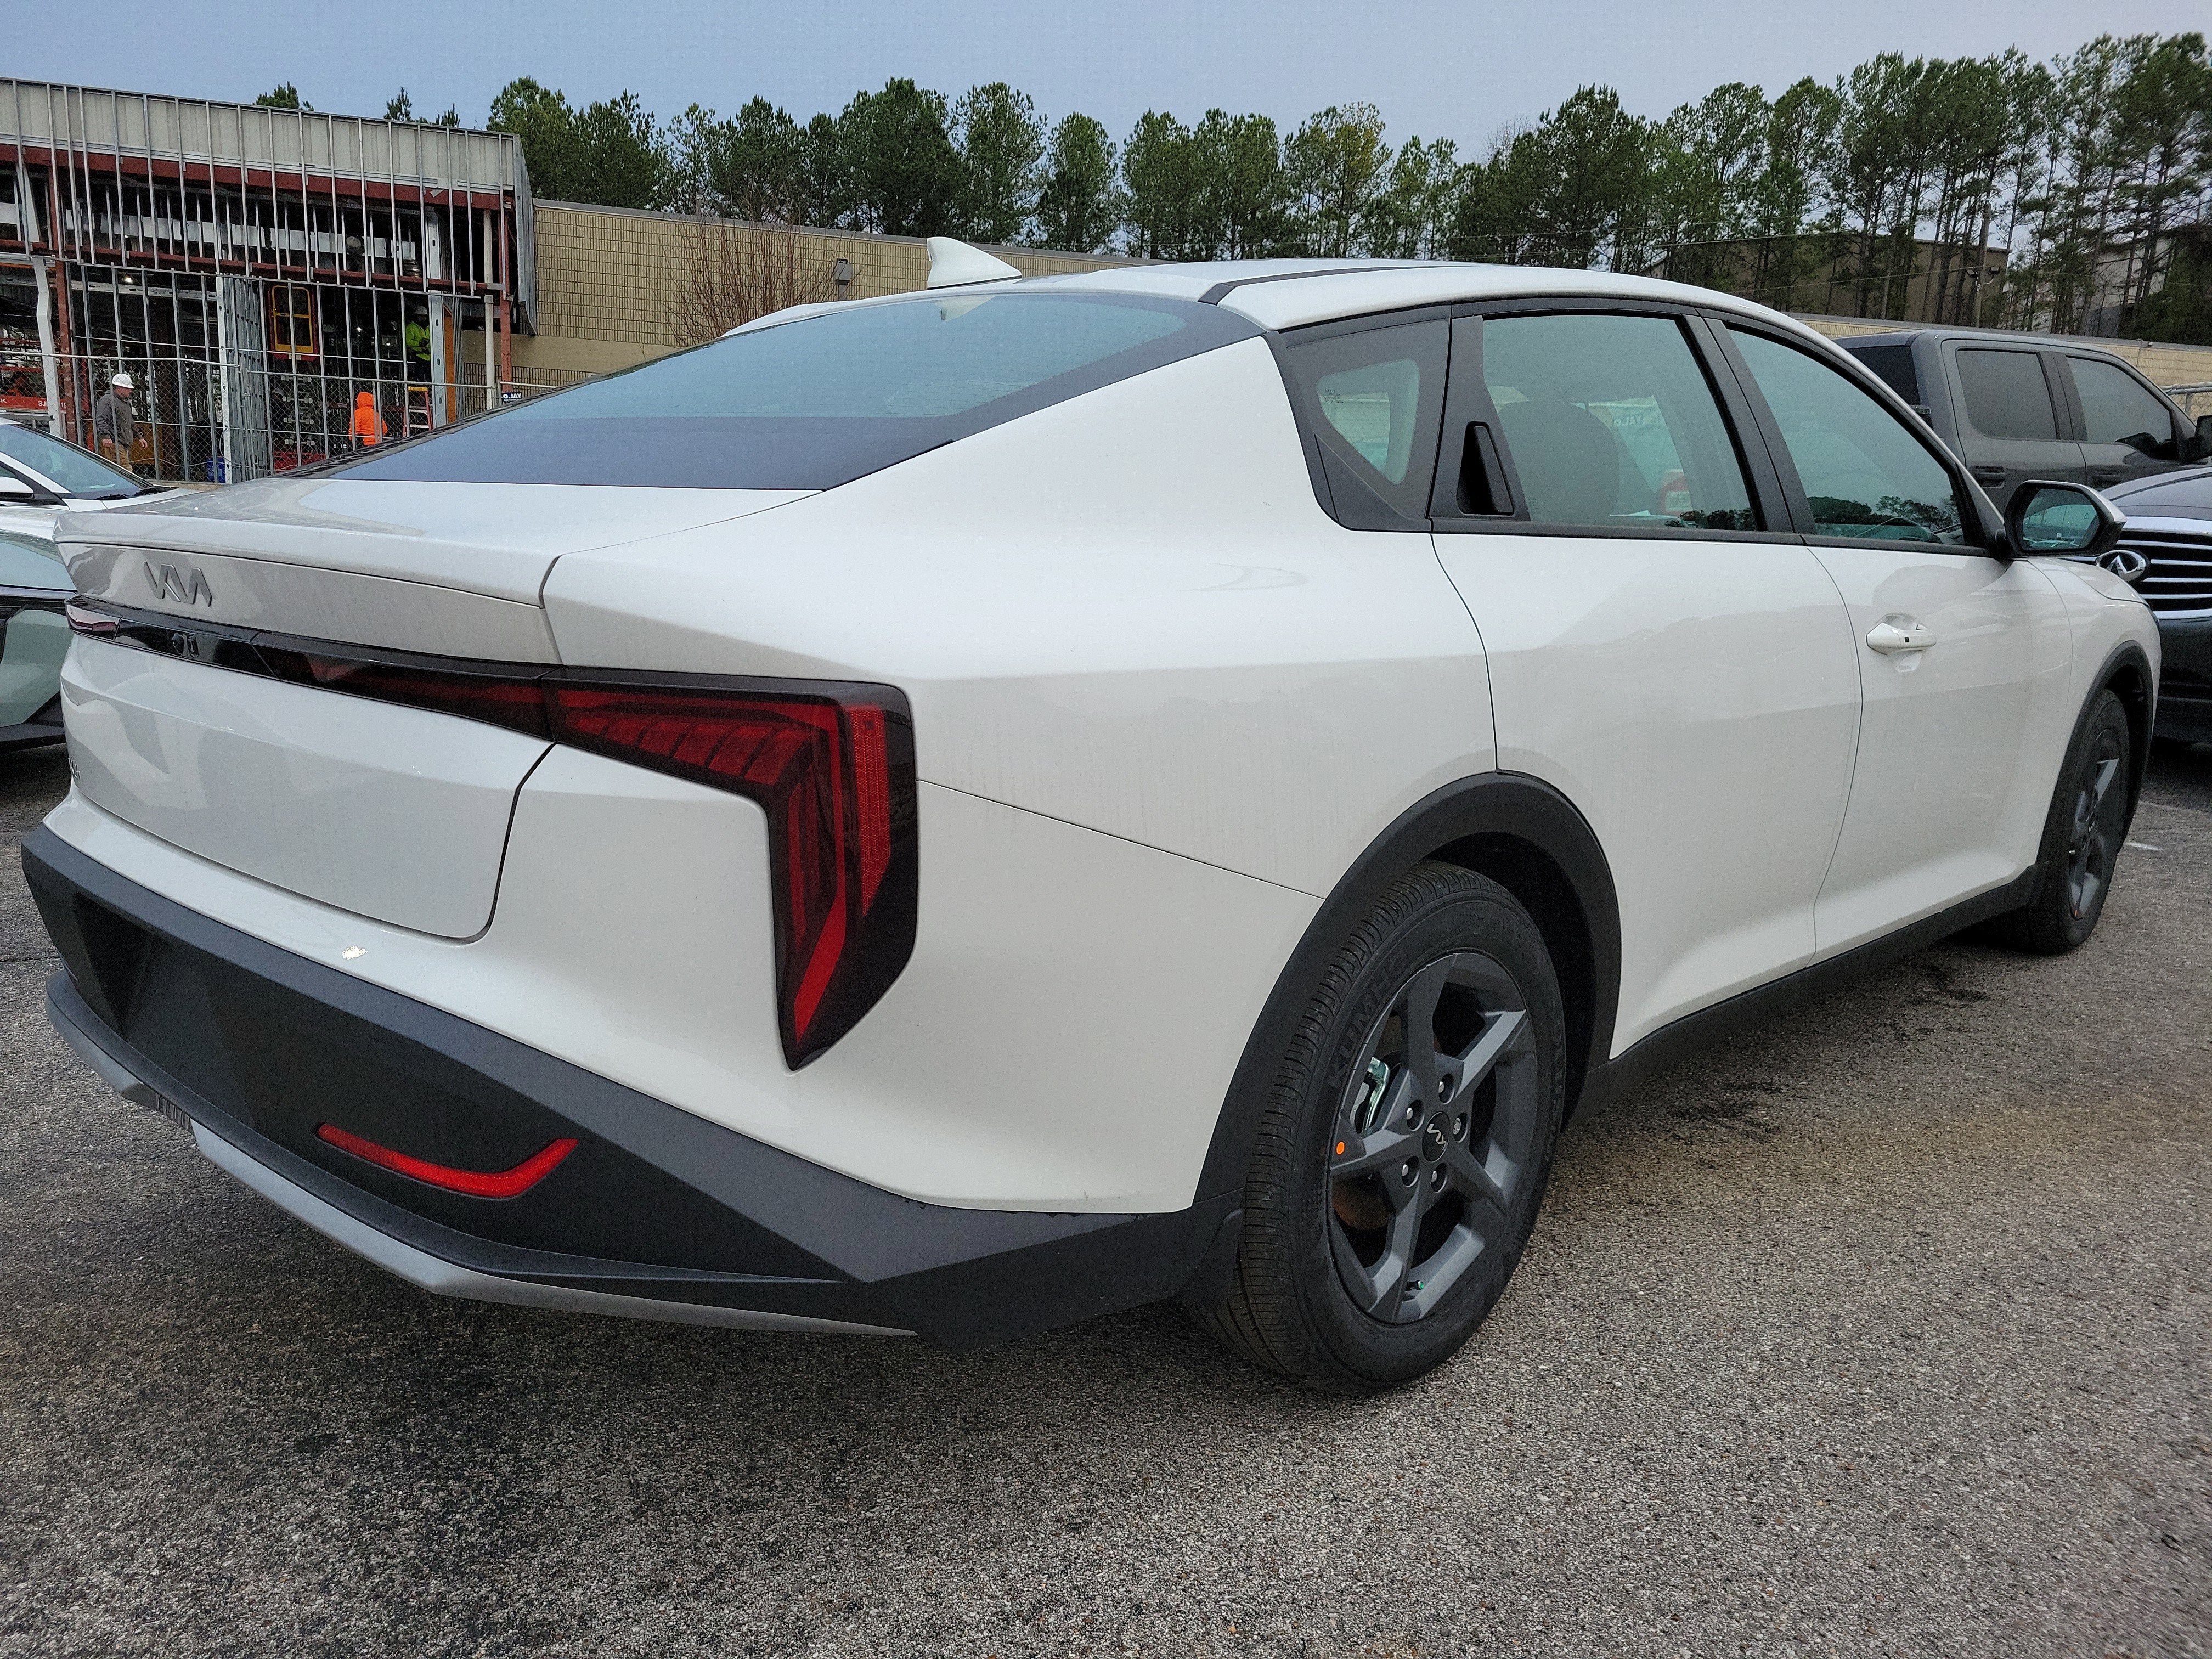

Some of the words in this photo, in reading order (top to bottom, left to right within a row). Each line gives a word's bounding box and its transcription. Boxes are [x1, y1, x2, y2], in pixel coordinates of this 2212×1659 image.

[143, 560, 213, 607] KIA
[1328, 951, 1406, 1088] KUMHO
[1427, 1124, 1447, 1150] KIA
